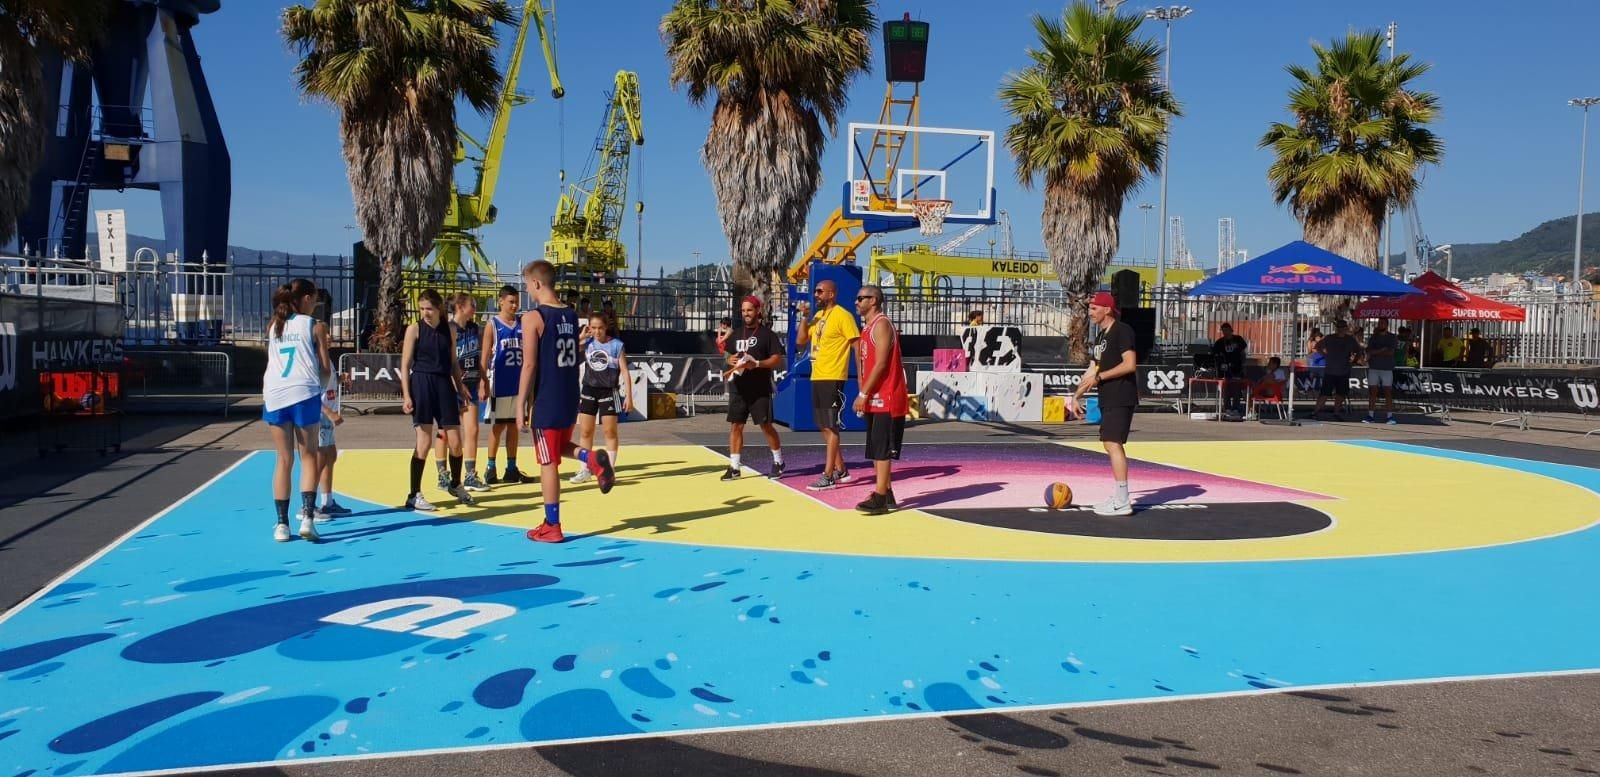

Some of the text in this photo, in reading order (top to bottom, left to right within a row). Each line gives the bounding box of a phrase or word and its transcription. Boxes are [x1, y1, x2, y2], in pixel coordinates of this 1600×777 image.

[107, 213, 115, 268] EXIT
[1260, 275, 1342, 285] Red Bull
[1359, 309, 1399, 318] SUPER BOCK
[1452, 308, 1502, 320] SUPER BOCK
[504, 350, 522, 367] 25
[555, 338, 577, 367] 23
[279, 346, 296, 378] 7
[1461, 384, 1560, 400] HAWKERS
